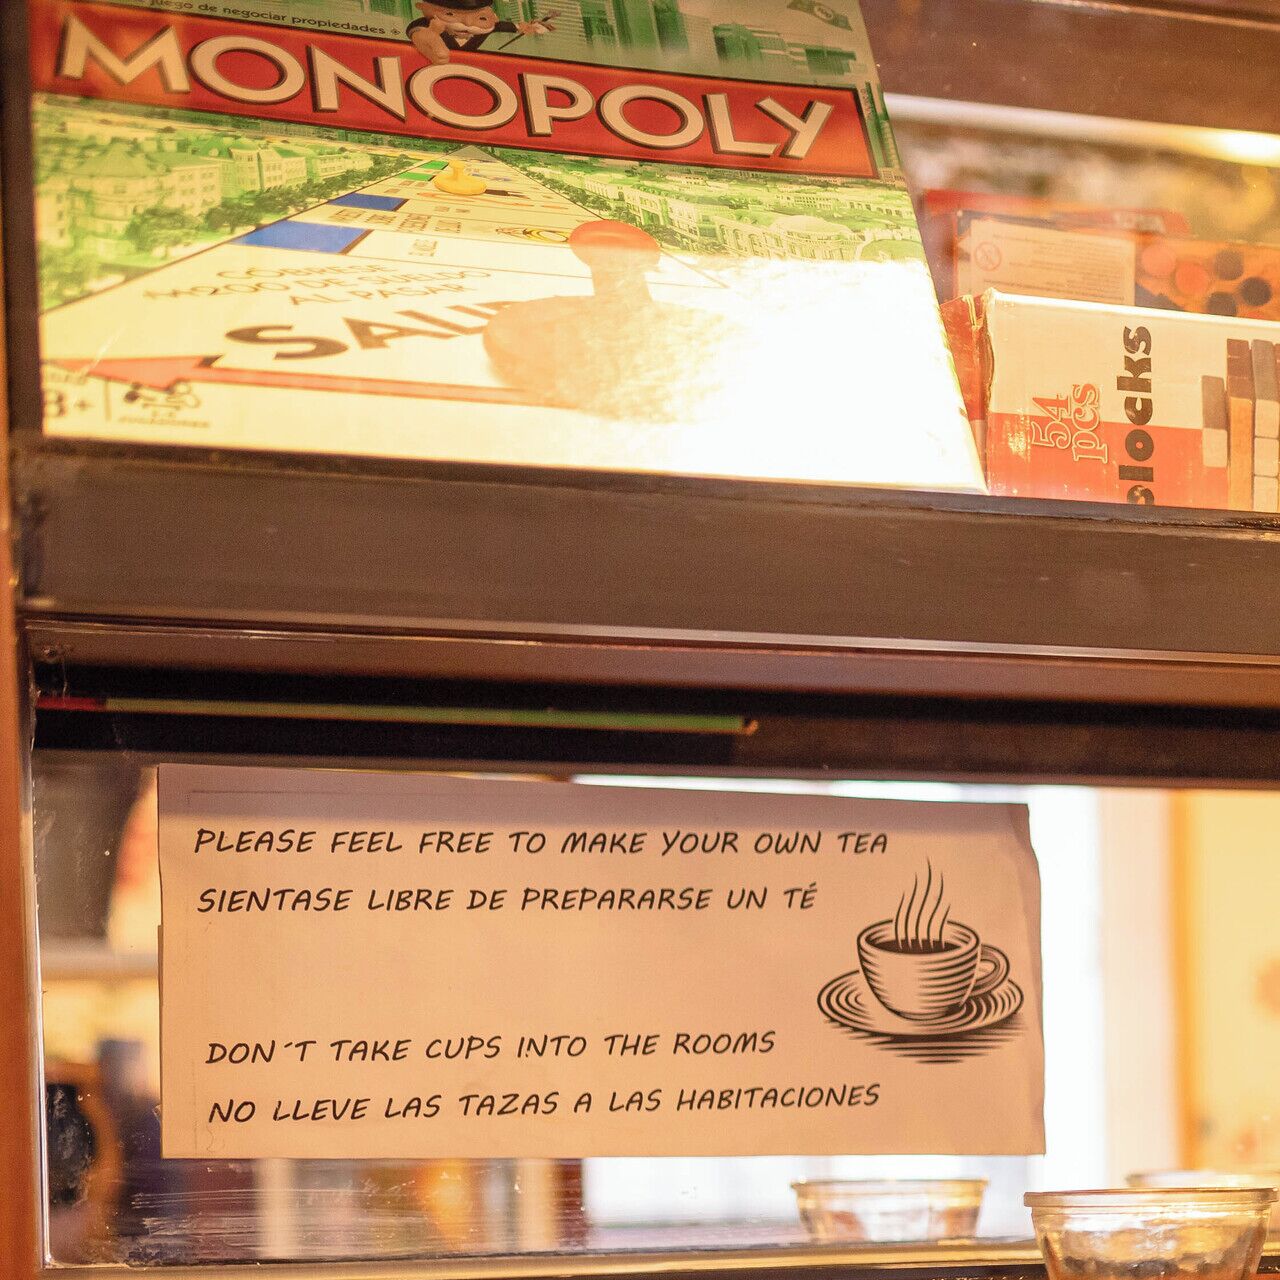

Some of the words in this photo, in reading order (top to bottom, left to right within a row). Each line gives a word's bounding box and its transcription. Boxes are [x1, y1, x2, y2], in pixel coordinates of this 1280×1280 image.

[198, 3, 218, 13] de
[222, 6, 287, 22] negociar
[291, 15, 386, 35] propiedades
[58, 15, 834, 158] MONOPOLY
[225, 301, 526, 361] SALI
[1031, 394, 1072, 450] 54
[1071, 383, 1108, 464] pcs
[195, 828, 316, 854] PLEASE
[331, 831, 403, 854] FEEL
[418, 831, 493, 854] FREE
[508, 831, 547, 854] TO
[560, 832, 648, 855] MAKE
[661, 830, 739, 857] YOUR
[753, 830, 822, 855] OWN
[837, 832, 888, 855] TEA
[196, 887, 354, 914] SIENTASE
[367, 888, 455, 912] LIBRE
[466, 889, 508, 911] DE
[520, 887, 714, 912] PREPARARSE
[726, 886, 768, 910] UN
[783, 881, 818, 910] TÉ
[330, 1038, 412, 1062] TAKE
[425, 1034, 502, 1060] CUPS
[516, 1034, 587, 1059] INTO
[603, 1033, 661, 1057] THE
[672, 1030, 776, 1055] ROOMS
[208, 1098, 256, 1124] NO
[272, 1097, 372, 1122] LLEVE
[384, 1094, 442, 1119] LAS
[458, 1090, 560, 1117] TAZAS
[573, 1091, 592, 1114] A
[608, 1088, 663, 1113] LAS
[676, 1084, 881, 1112] HABITACIONES
